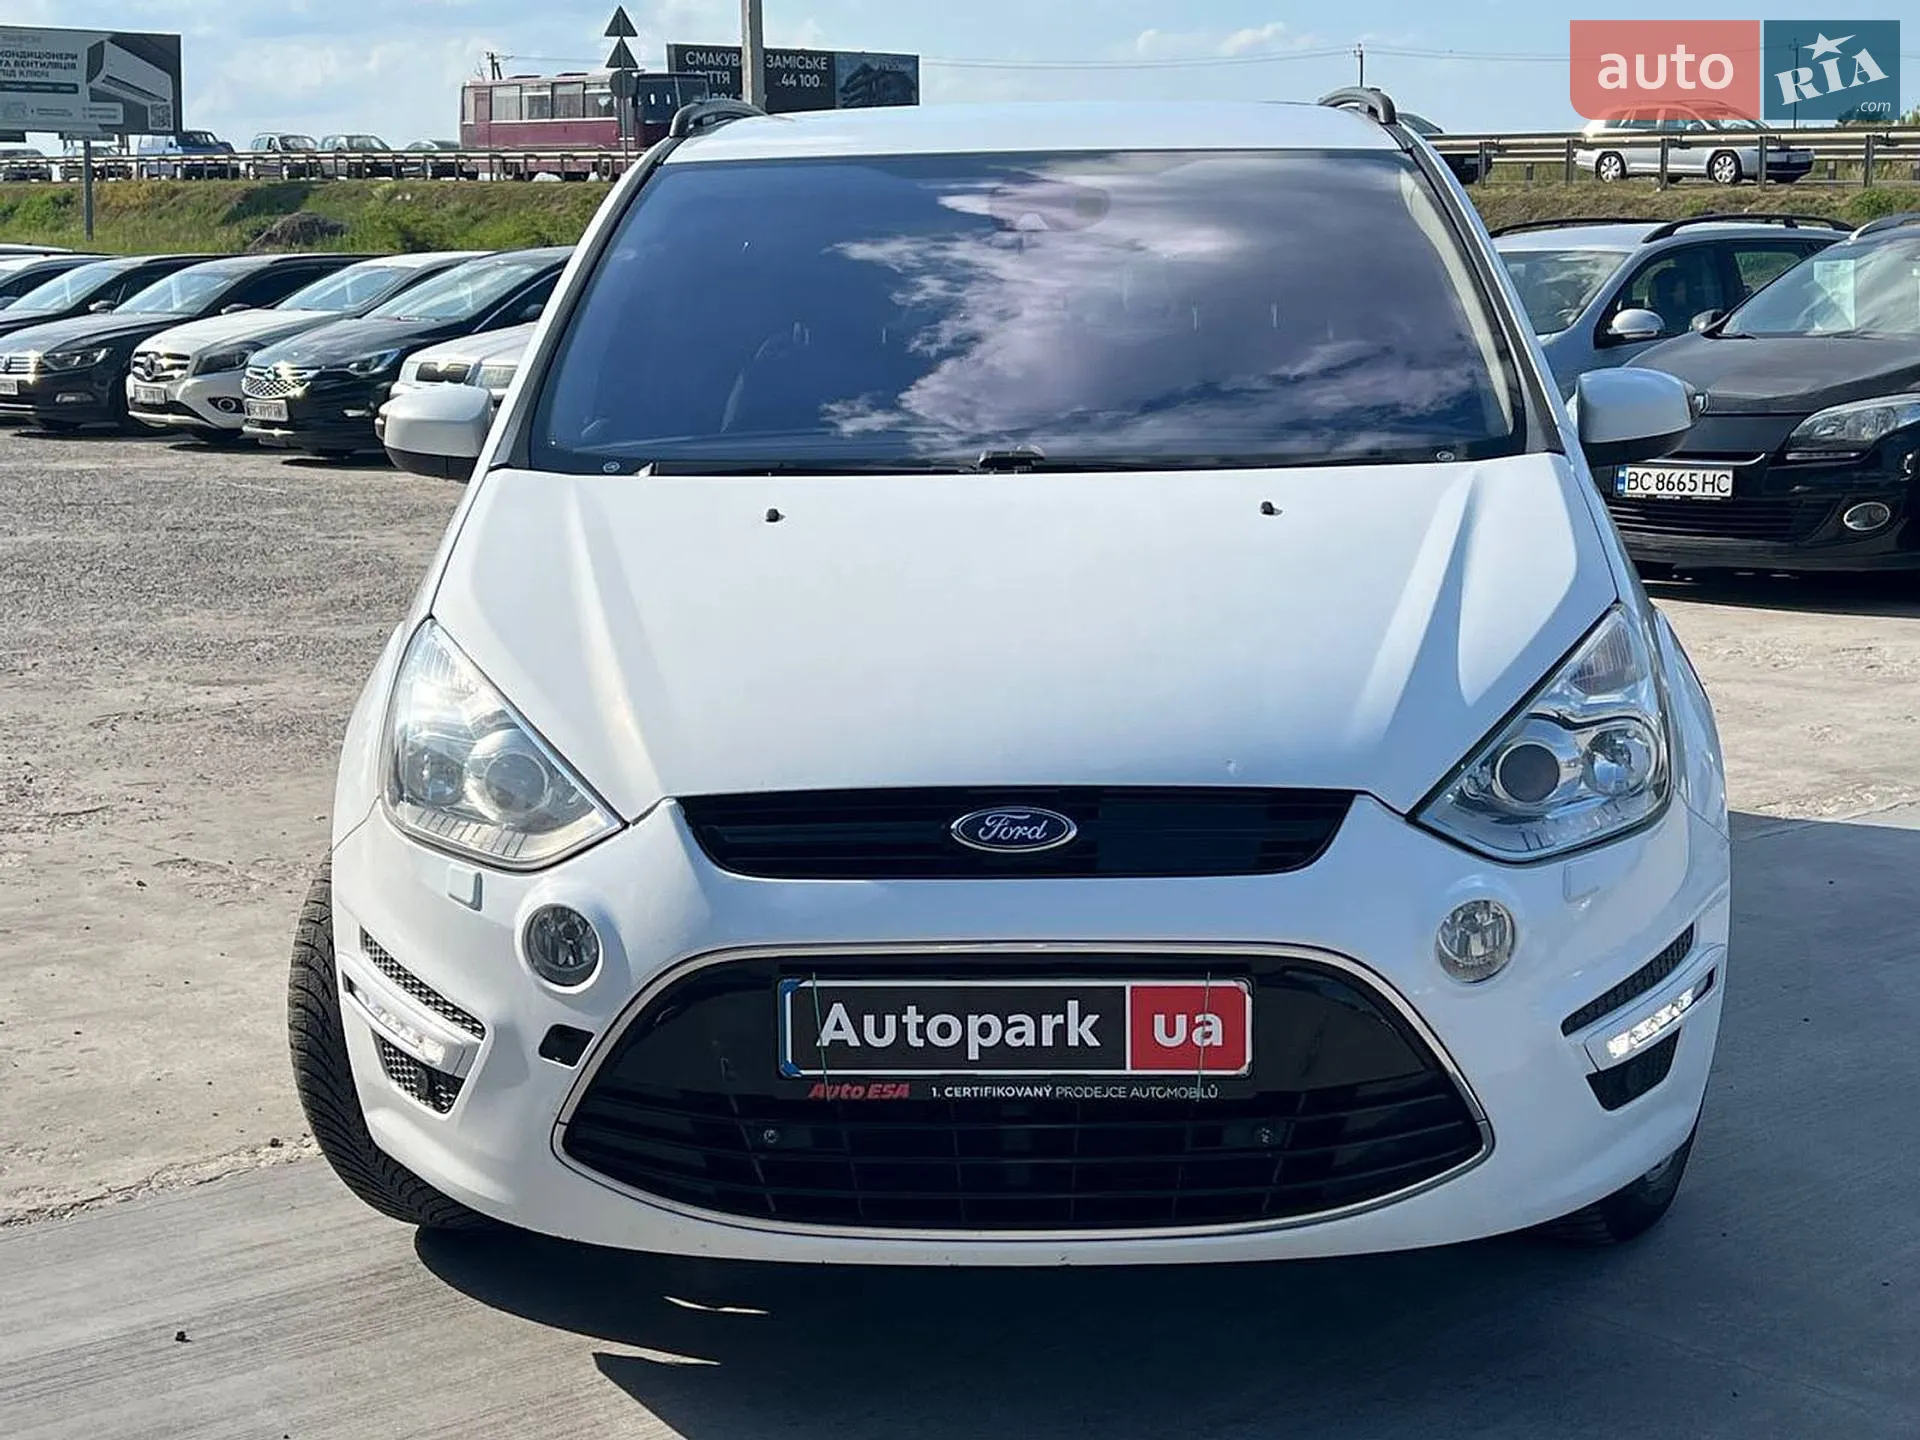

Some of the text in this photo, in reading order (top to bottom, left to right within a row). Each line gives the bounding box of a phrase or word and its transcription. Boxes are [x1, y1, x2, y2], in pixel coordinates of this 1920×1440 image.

[766, 54, 828, 70] ЗАМІСЬКЕ
[1627, 471, 1730, 493] BC 8665 HC
[978, 813, 1048, 841] Ford
[815, 999, 1225, 1060] Autopark ua
[932, 1087, 941, 1098] 1.
[944, 1084, 1052, 1098] CERTIFIKOVANÝ
[1056, 1086, 1126, 1098] PRODEJCE
